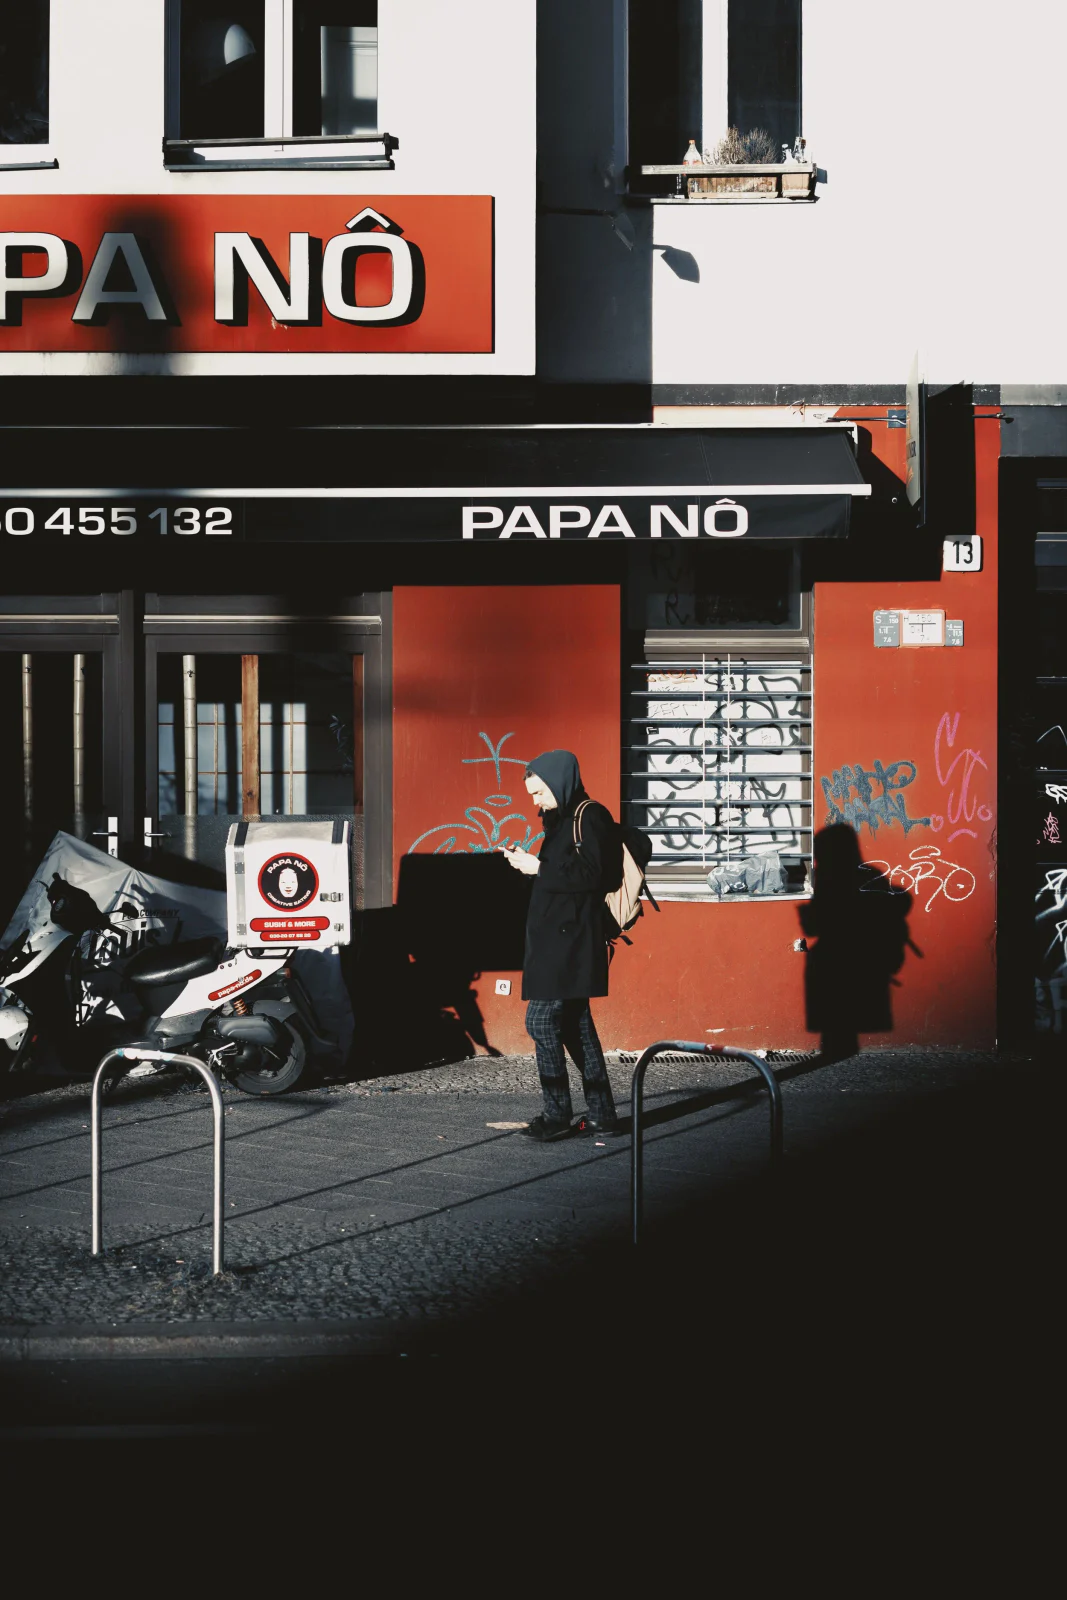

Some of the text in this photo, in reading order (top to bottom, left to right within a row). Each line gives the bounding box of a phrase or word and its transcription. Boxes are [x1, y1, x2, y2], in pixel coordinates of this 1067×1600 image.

[213, 206, 414, 322] NÔ
[44, 507, 138, 536] 455
[148, 506, 233, 536] 132
[462, 497, 749, 539] PAPA NÔ
[952, 540, 974, 565] 13
[266, 858, 293, 874] PAPA
[294, 920, 316, 928] MORE
